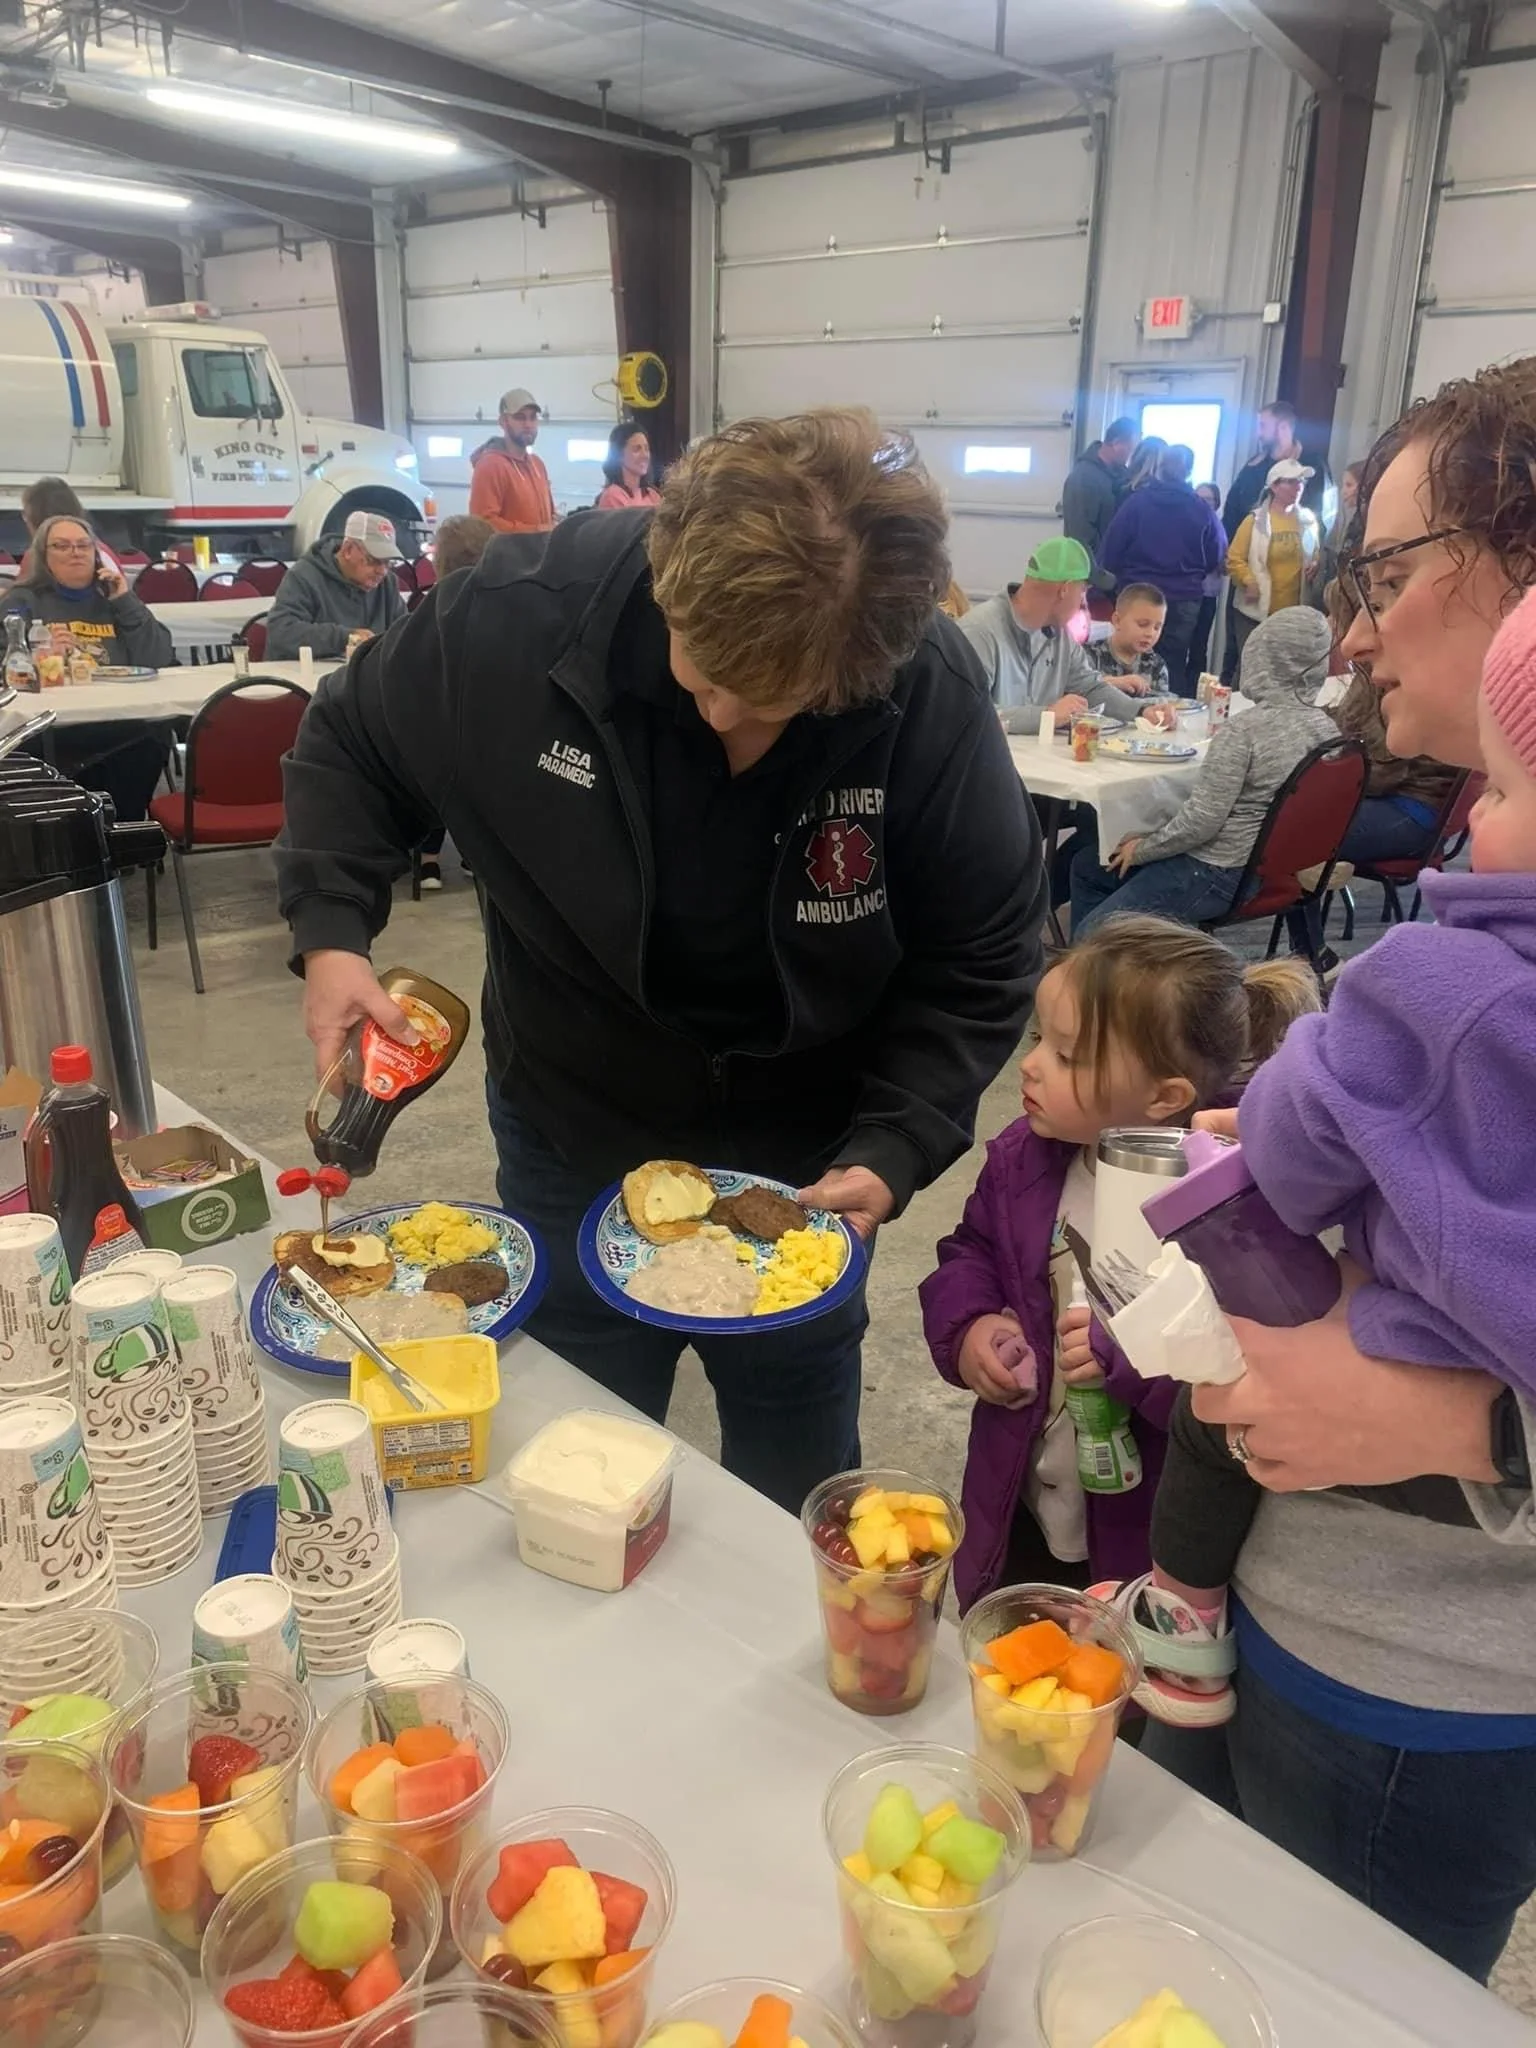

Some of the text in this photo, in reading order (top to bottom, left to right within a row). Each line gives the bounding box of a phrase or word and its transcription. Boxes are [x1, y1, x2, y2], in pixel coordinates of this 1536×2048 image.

[1152, 300, 1183, 327] EXIT
[214, 441, 285, 460] KING CITY
[551, 740, 591, 770] LISA
[537, 753, 596, 789] PARAMEDIC
[839, 788, 885, 815] RIVER
